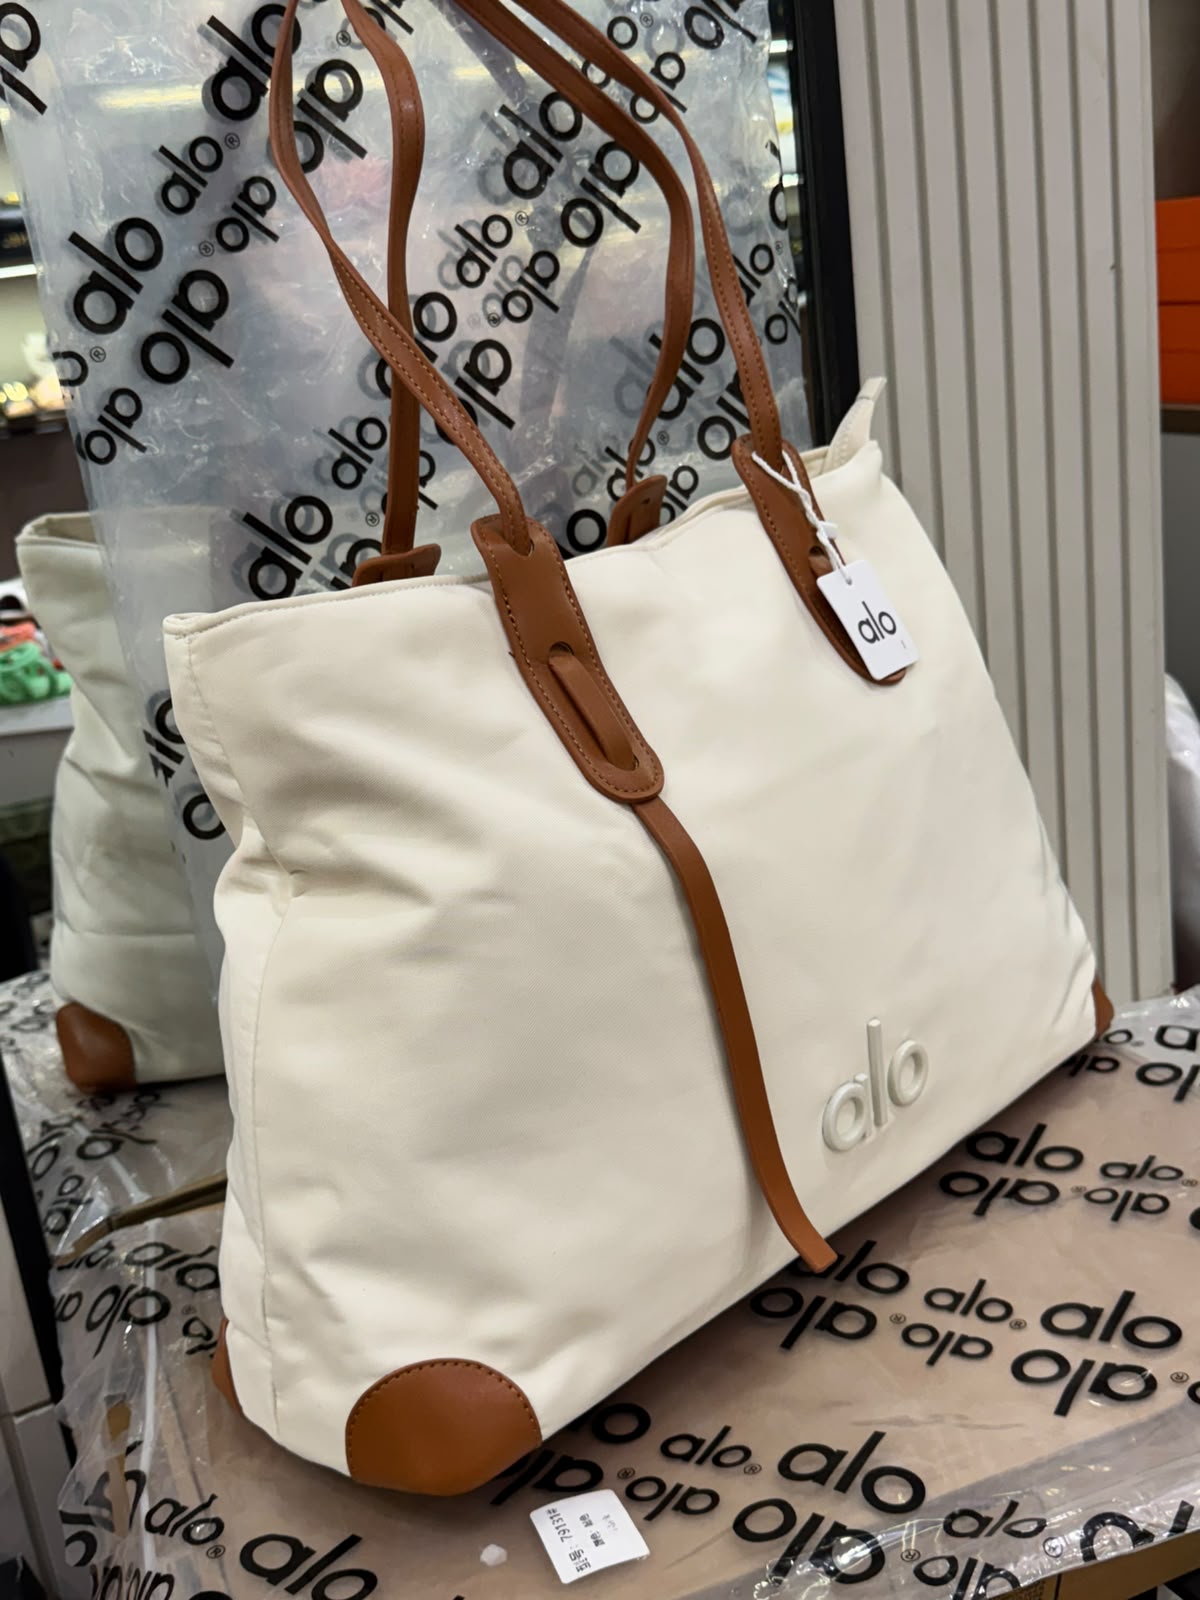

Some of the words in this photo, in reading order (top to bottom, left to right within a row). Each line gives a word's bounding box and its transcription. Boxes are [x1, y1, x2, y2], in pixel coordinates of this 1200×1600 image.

[0, 2, 47, 115] al
[499, 91, 583, 199] alo
[561, 141, 642, 247] alo
[68, 217, 164, 334] alo
[140, 269, 235, 384] alo
[328, 417, 387, 490] alo
[243, 495, 333, 601] alo
[857, 600, 897, 644] alo
[822, 1017, 929, 1152] alo
[965, 1123, 1084, 1172] alo
[939, 1171, 1060, 1217] alo
[750, 1287, 878, 1351] alo
[1040, 1290, 1183, 1349] alo
[1011, 1349, 1158, 1417] alo
[778, 1430, 926, 1514] alo
[240, 1534, 379, 1600] alo
[733, 1498, 886, 1586] alo
